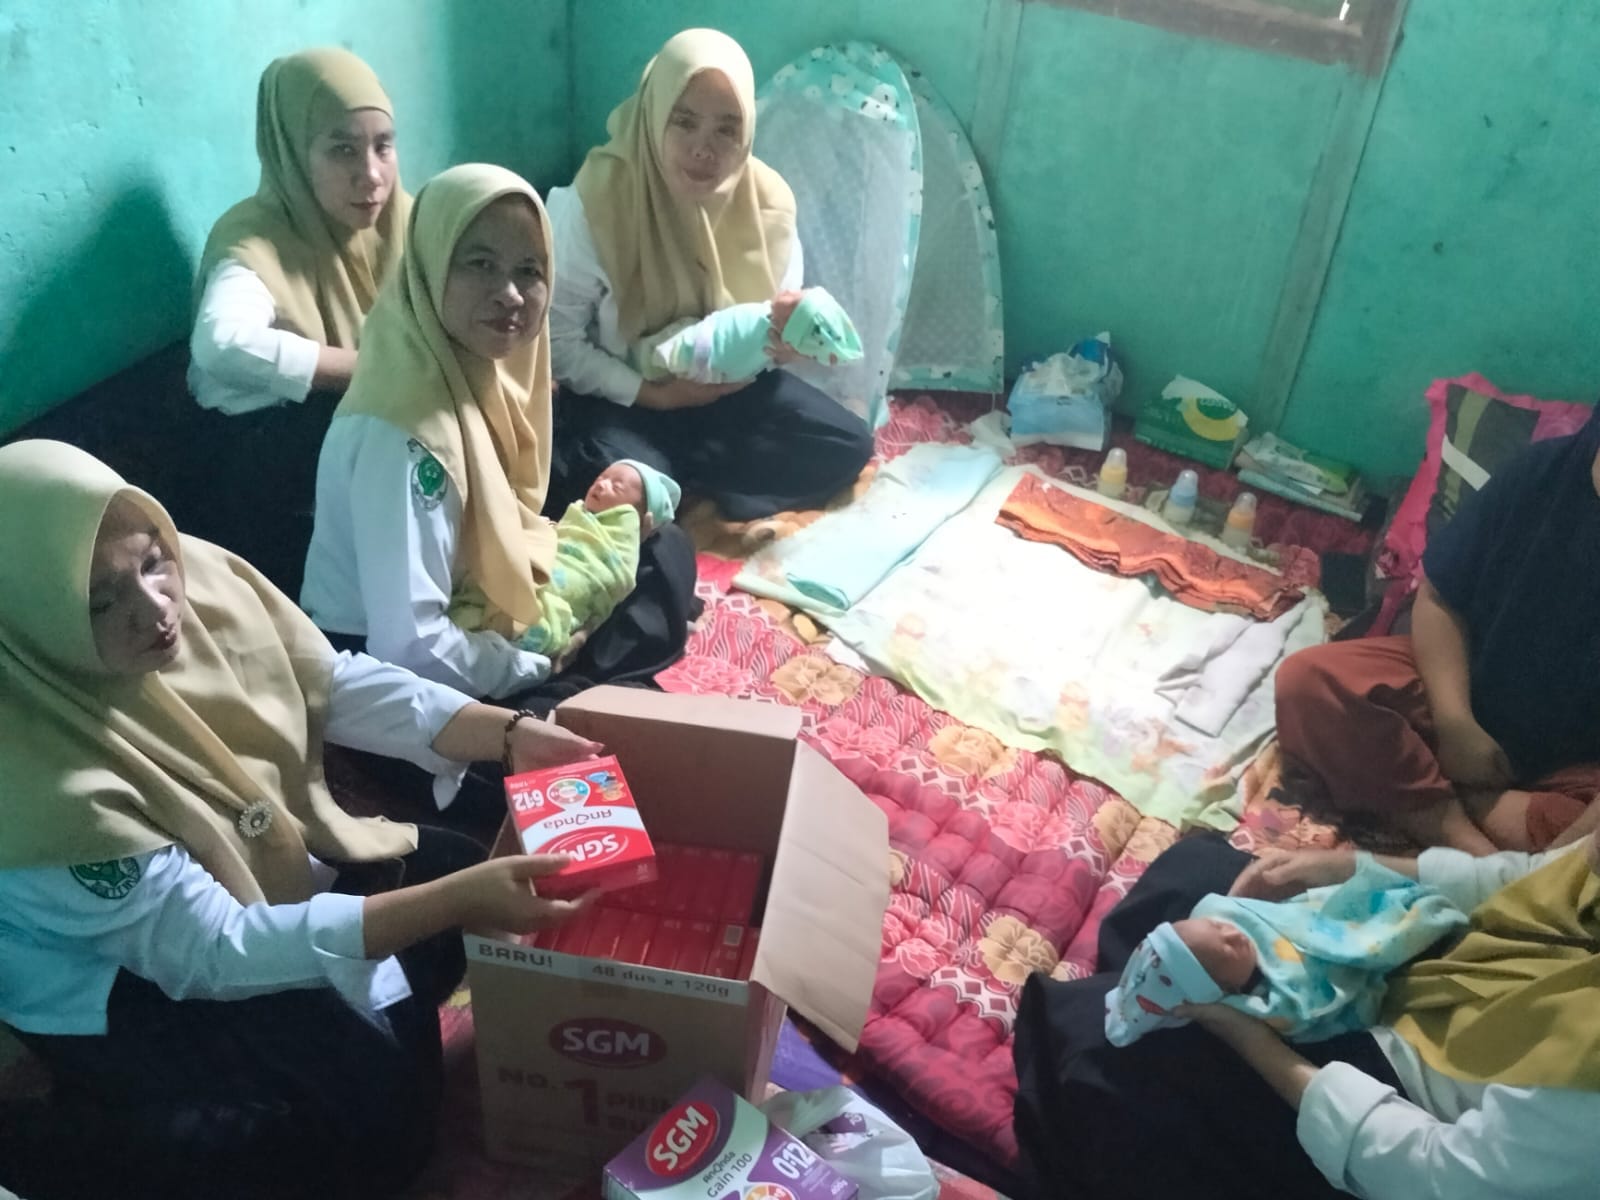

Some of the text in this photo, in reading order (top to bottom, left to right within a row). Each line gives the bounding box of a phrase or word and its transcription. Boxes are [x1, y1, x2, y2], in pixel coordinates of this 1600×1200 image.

[478, 944, 553, 969] BARU!
[591, 964, 616, 978] 48
[622, 970, 657, 985] dus
[683, 979, 730, 999] 120g
[562, 1026, 650, 1057] SGM
[652, 1105, 709, 1171] SGM
[706, 1153, 753, 1199] Gain 100
